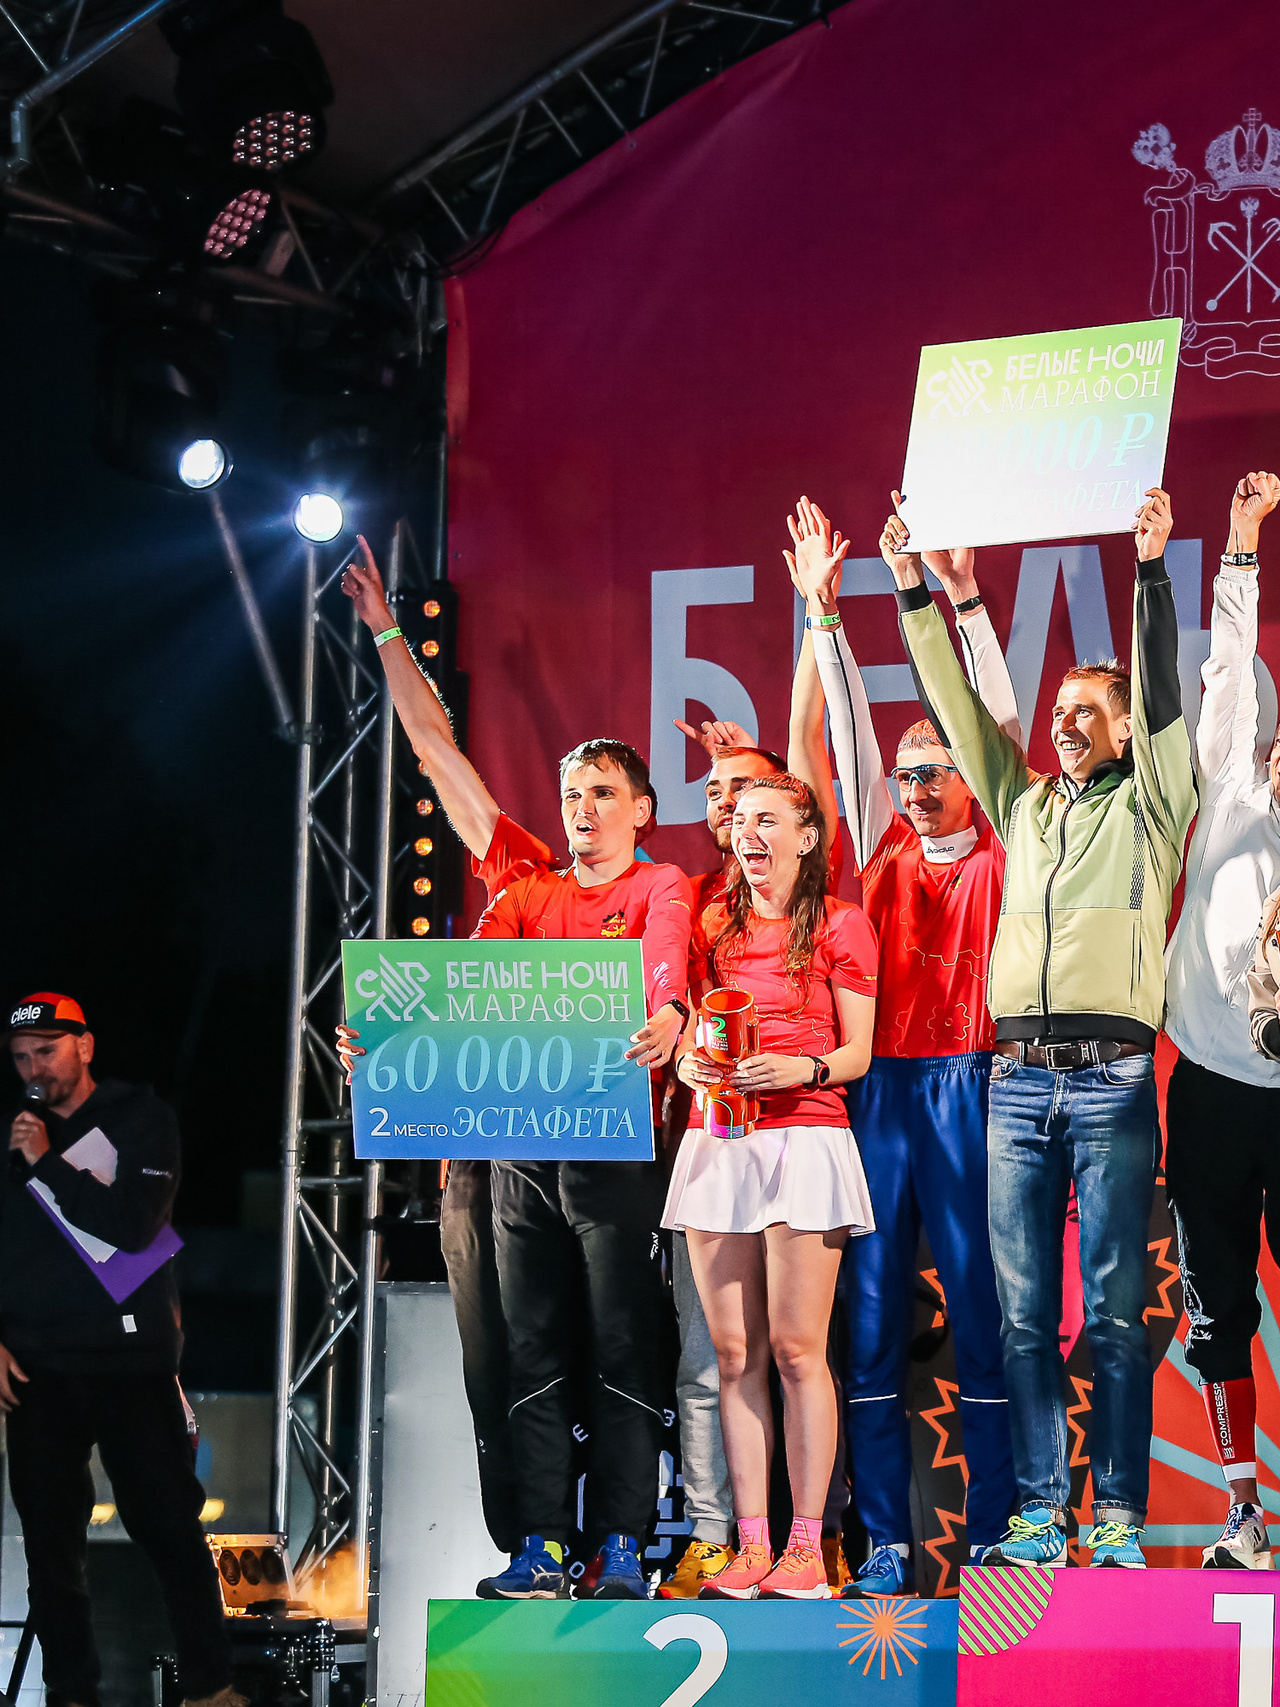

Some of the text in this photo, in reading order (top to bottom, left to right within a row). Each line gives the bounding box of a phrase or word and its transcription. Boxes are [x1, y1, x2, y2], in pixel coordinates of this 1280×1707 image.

[1005, 338, 1165, 382] БЕЛЫЕ НОЧИ
[1000, 369, 1162, 414] МАРАФОН
[446, 961, 629, 989] БЕЛЫЕ НОЧИ
[445, 993, 632, 1023] МАРАФОН
[710, 1016, 727, 1037] 2
[367, 1033, 439, 1093] 60
[456, 1034, 573, 1093] 000
[369, 1105, 637, 1139] 2 МЕСТО ЭСТАФЕТА
[642, 1612, 728, 1707] 2
[1213, 1592, 1275, 1707] 1
